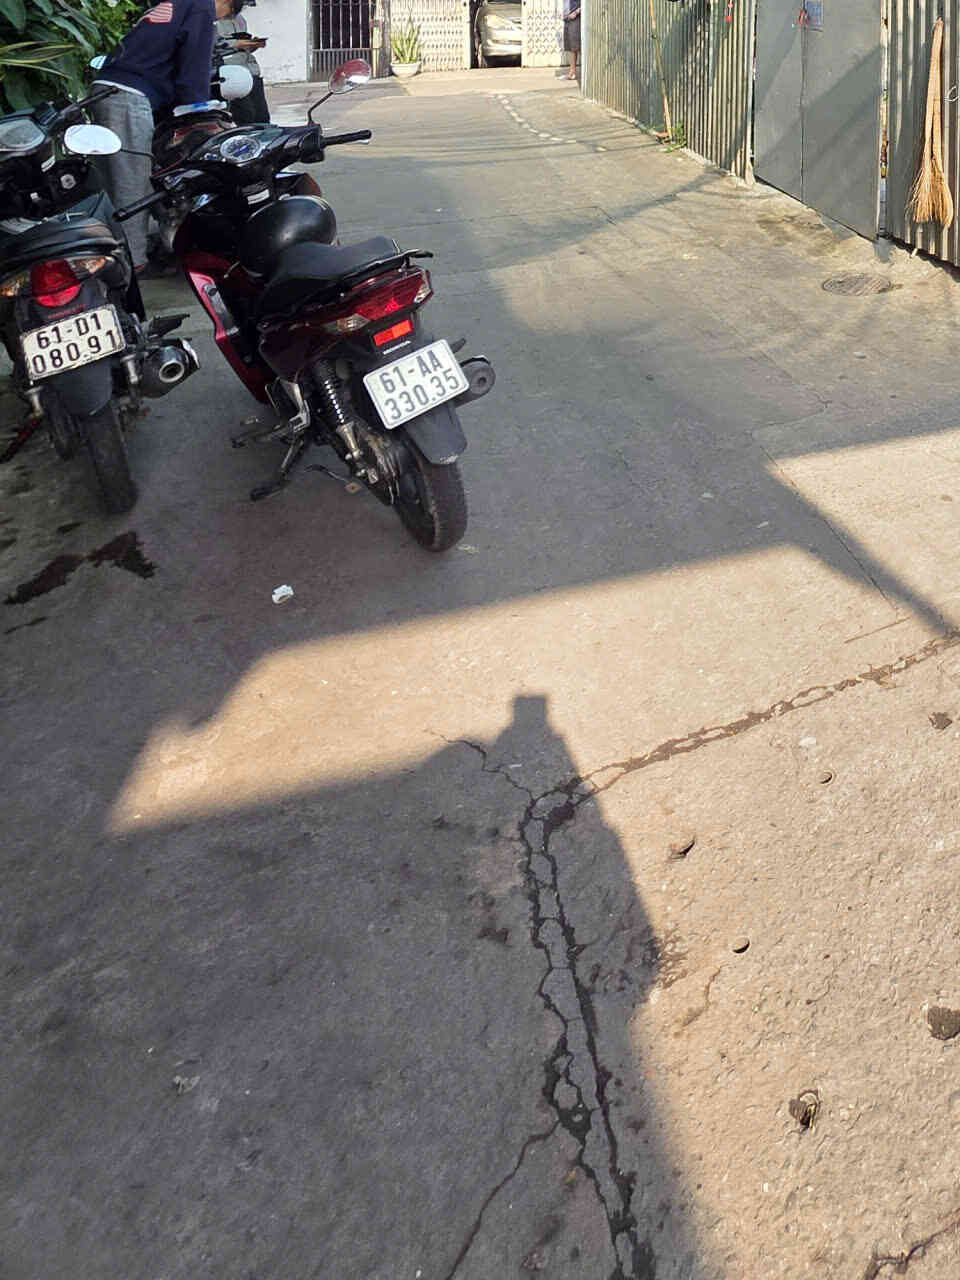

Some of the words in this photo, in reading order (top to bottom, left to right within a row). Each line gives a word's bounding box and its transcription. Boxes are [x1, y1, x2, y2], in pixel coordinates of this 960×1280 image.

[32, 330, 117, 374] 080.91
[36, 313, 101, 349] 61-D1
[379, 350, 443, 394] 61-AA
[384, 368, 460, 420] 330.35
